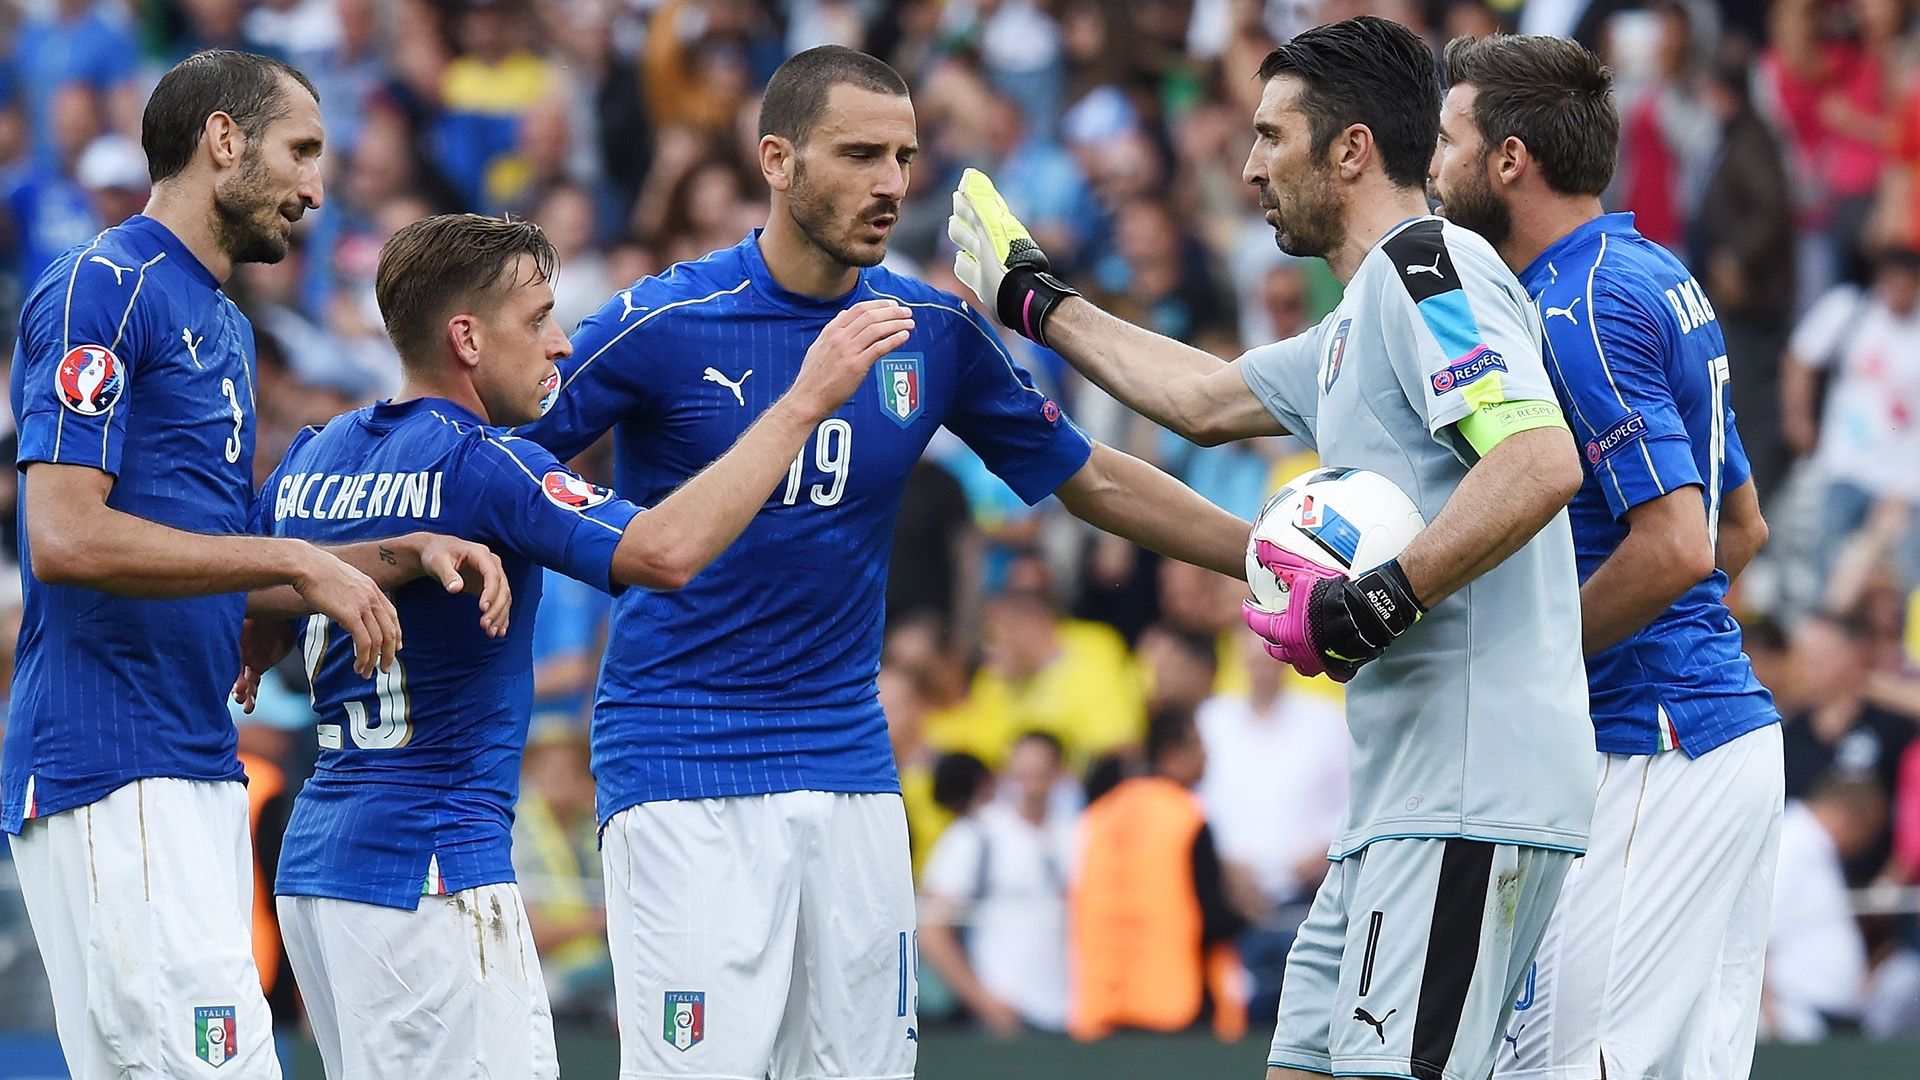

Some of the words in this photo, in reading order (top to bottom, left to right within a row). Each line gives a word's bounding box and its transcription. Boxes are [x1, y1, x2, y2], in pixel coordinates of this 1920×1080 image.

[886, 363, 914, 371] ITALIA
[1454, 354, 1505, 381] RESPECT
[222, 378, 243, 463] 3
[1599, 416, 1644, 452] RESPECT
[783, 418, 852, 507] 19
[1366, 590, 1391, 620] BUFFON
[669, 994, 701, 1002] ITALIA
[199, 1009, 231, 1017] ITALIA
